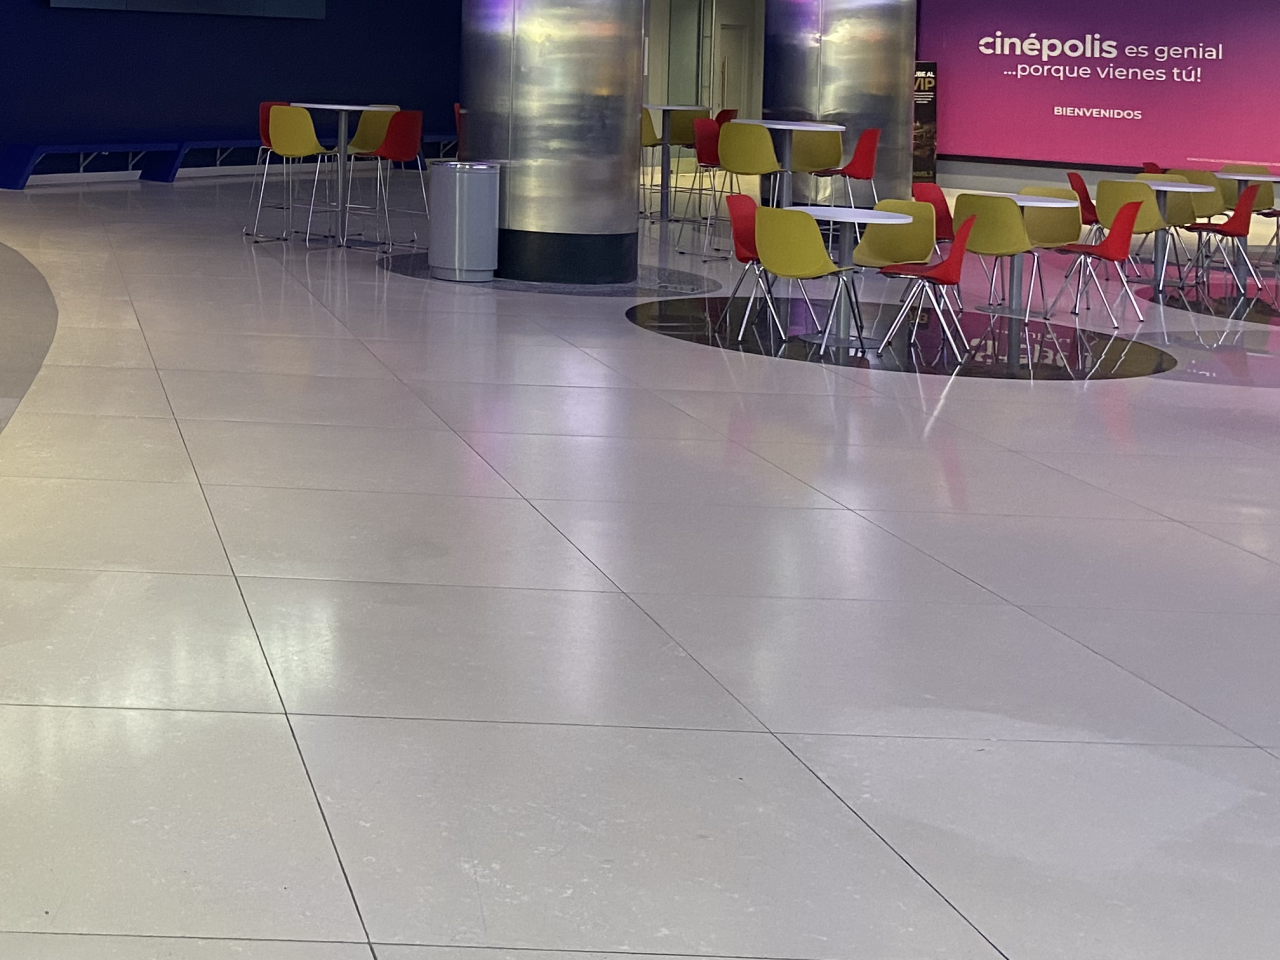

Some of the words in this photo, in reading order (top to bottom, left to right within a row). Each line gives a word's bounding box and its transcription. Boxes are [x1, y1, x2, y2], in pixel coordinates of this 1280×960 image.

[977, 30, 1118, 61] cinépolis
[1124, 45, 1149, 58] es
[1154, 43, 1223, 62] genial
[1003, 63, 1092, 81] ...porque
[1096, 63, 1167, 81] vienes
[1171, 67, 1202, 83] tú!
[1053, 106, 1142, 120] BIENVENIDOS
